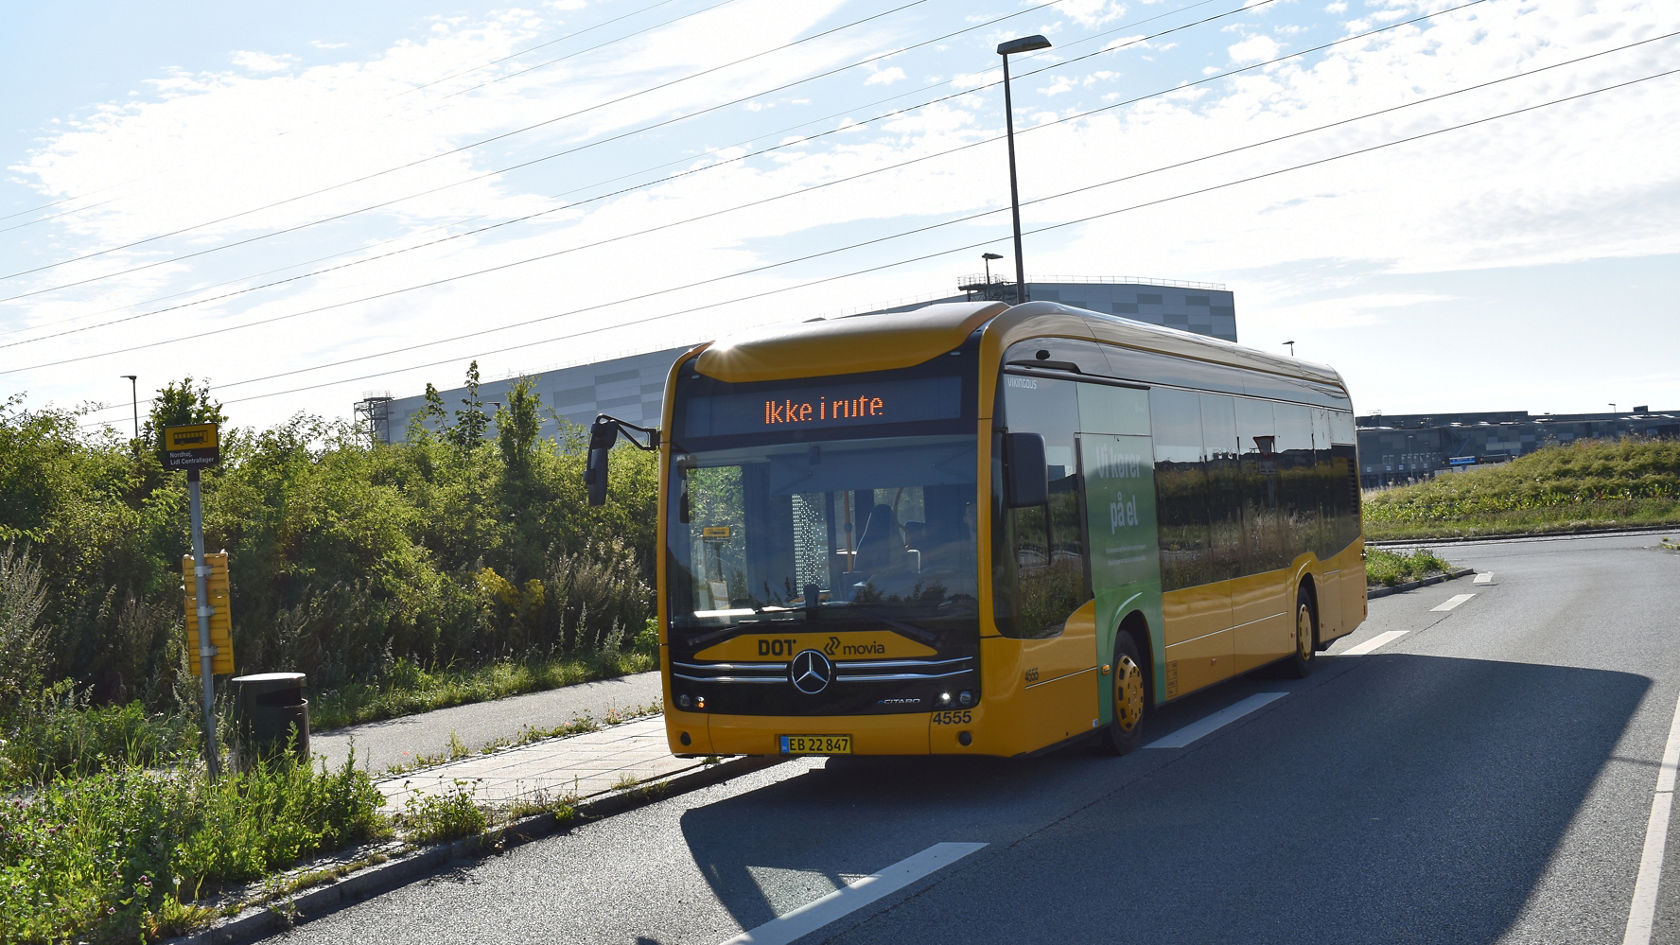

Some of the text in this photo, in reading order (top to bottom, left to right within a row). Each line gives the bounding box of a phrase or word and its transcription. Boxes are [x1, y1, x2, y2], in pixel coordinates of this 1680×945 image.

[765, 395, 884, 424] Ikke i rute
[1095, 444, 1109, 479] Vi
[1110, 491, 1138, 535] på el
[843, 641, 885, 655] movia
[1024, 667, 1039, 682] 4555
[932, 711, 972, 725] 4555
[789, 738, 849, 752] EB 22 847
